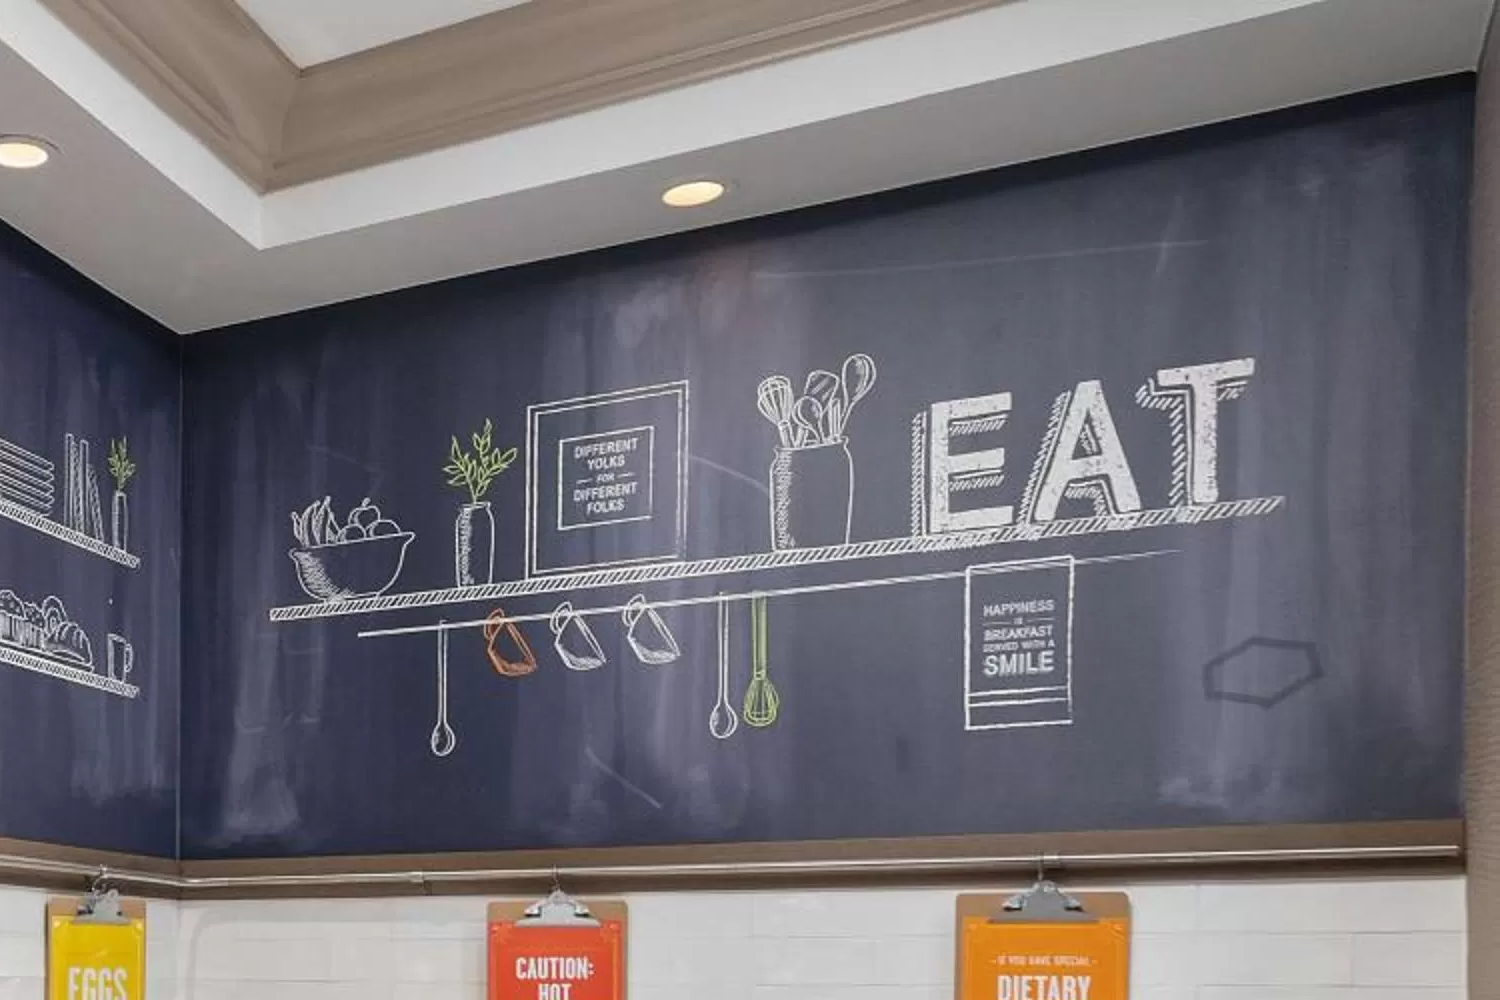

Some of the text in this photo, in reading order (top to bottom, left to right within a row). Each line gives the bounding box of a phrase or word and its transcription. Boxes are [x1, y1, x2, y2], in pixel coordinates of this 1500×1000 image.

[574, 437, 639, 459] DIFFERENT
[911, 358, 1255, 537] EAT
[587, 454, 625, 470] YOLKS
[596, 473, 615, 482] FOR
[573, 482, 638, 501] DIFFERENT
[586, 499, 625, 515] FOLKS
[983, 600, 1054, 616] HAPPINESS
[984, 624, 1053, 641] BREAKFAST
[1047, 639, 1055, 647] A
[984, 650, 1054, 675] SMILE
[515, 956, 595, 981] CAUTION:
